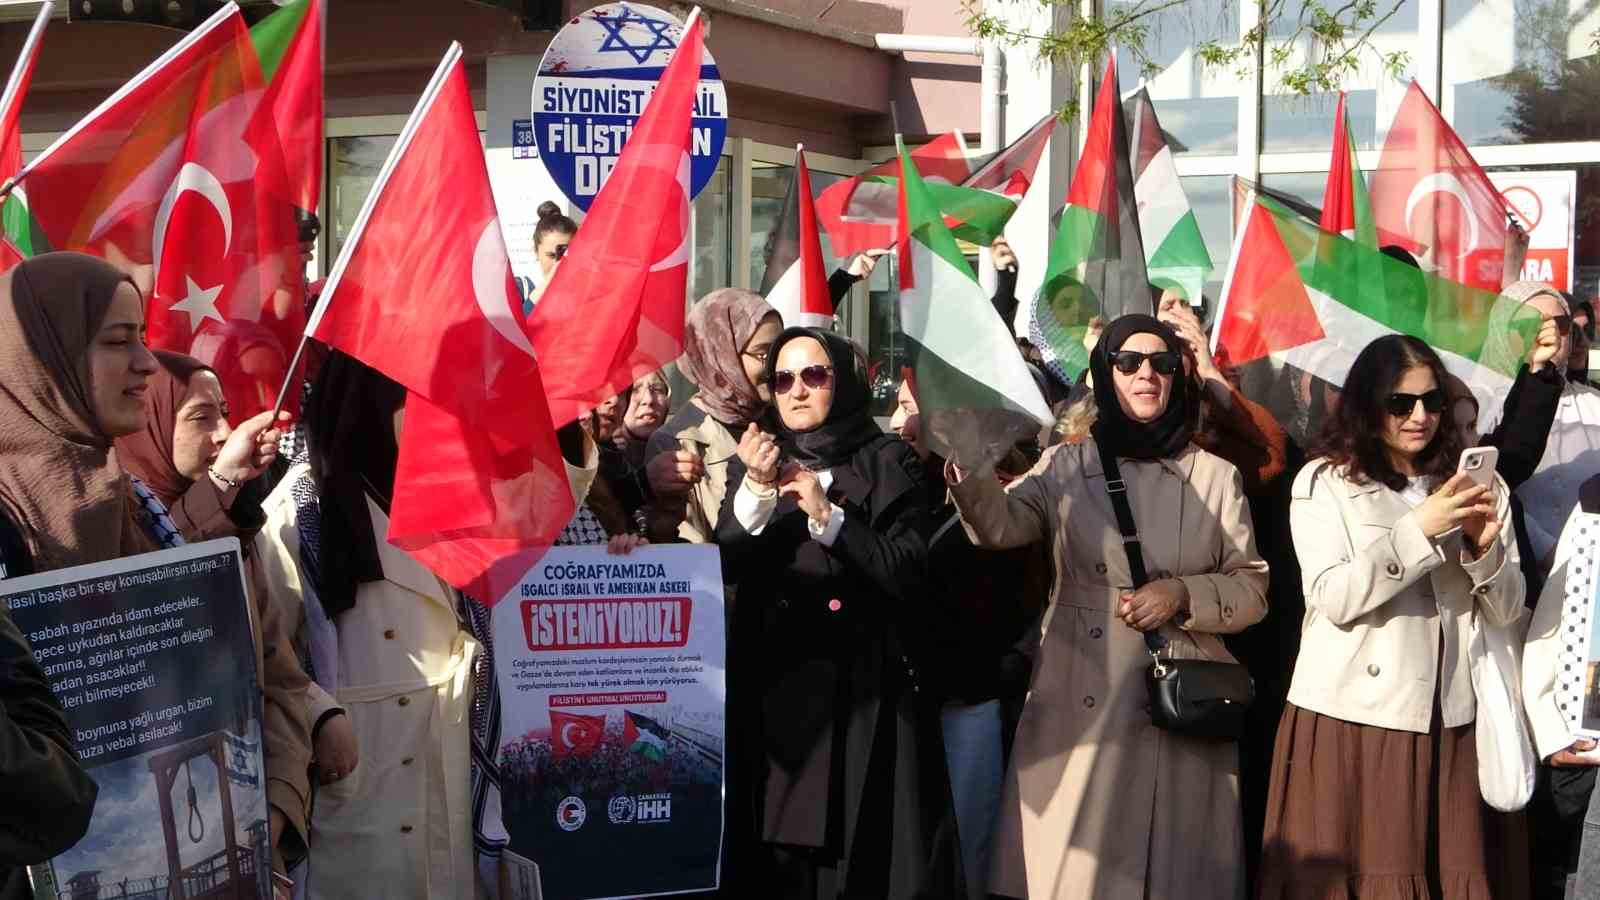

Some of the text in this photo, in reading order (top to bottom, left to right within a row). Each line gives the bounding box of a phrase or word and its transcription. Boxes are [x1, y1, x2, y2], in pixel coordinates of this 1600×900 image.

[543, 82, 645, 114] SİYONİST
[518, 131, 532, 145] 38
[38, 586, 77, 603] başka
[79, 582, 95, 596] bir
[97, 580, 117, 594] şey
[119, 565, 189, 587] konuşabilirsin
[593, 582, 605, 595] VE
[31, 623, 69, 642] sabah
[72, 612, 123, 634] ayazında
[125, 606, 152, 622] idam
[33, 617, 184, 662] gece uykudan kaldıracaklar
[531, 601, 682, 647] İSTEMİYORUZ!
[44, 658, 86, 676] arnına,
[126, 640, 159, 658] içinde
[161, 635, 180, 650] son
[52, 676, 83, 693] adan
[61, 695, 83, 709] leri
[76, 719, 128, 742] boynuna
[128, 711, 154, 731] yağlı
[187, 696, 213, 712] bizim
[106, 733, 136, 752] vebal
